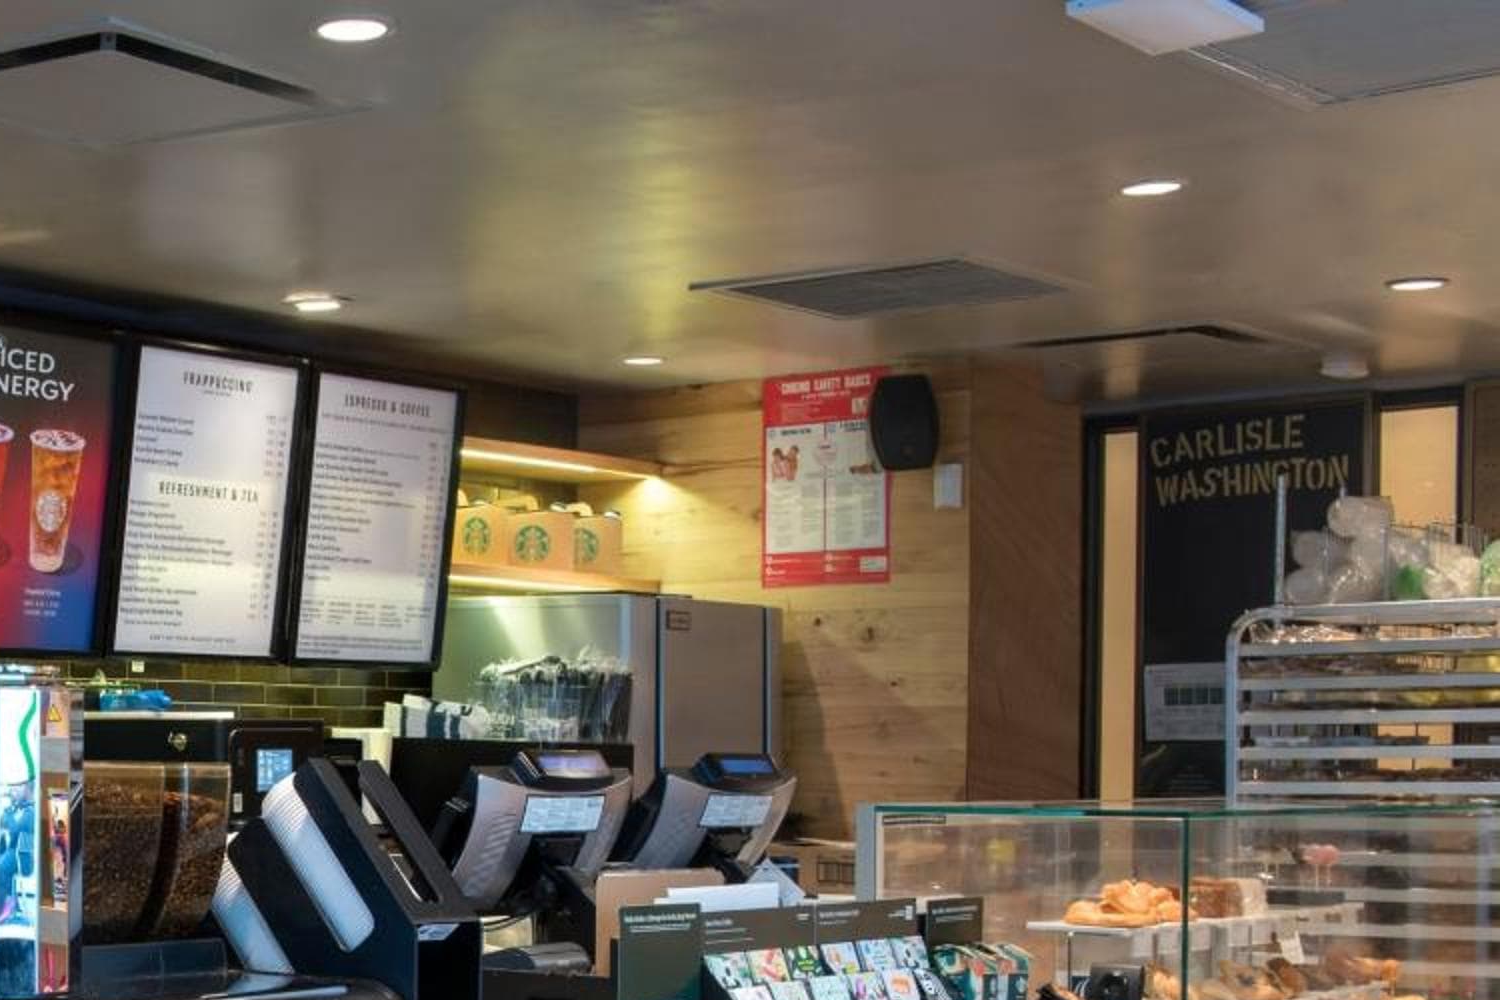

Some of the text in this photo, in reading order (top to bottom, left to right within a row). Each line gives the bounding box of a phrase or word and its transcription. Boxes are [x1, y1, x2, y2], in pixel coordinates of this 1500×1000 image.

[0, 347, 56, 374] ICED
[1150, 414, 1305, 467] CARLISLE
[158, 480, 227, 499] REFRESHMENT
[1155, 454, 1349, 507] WASHINGTON
